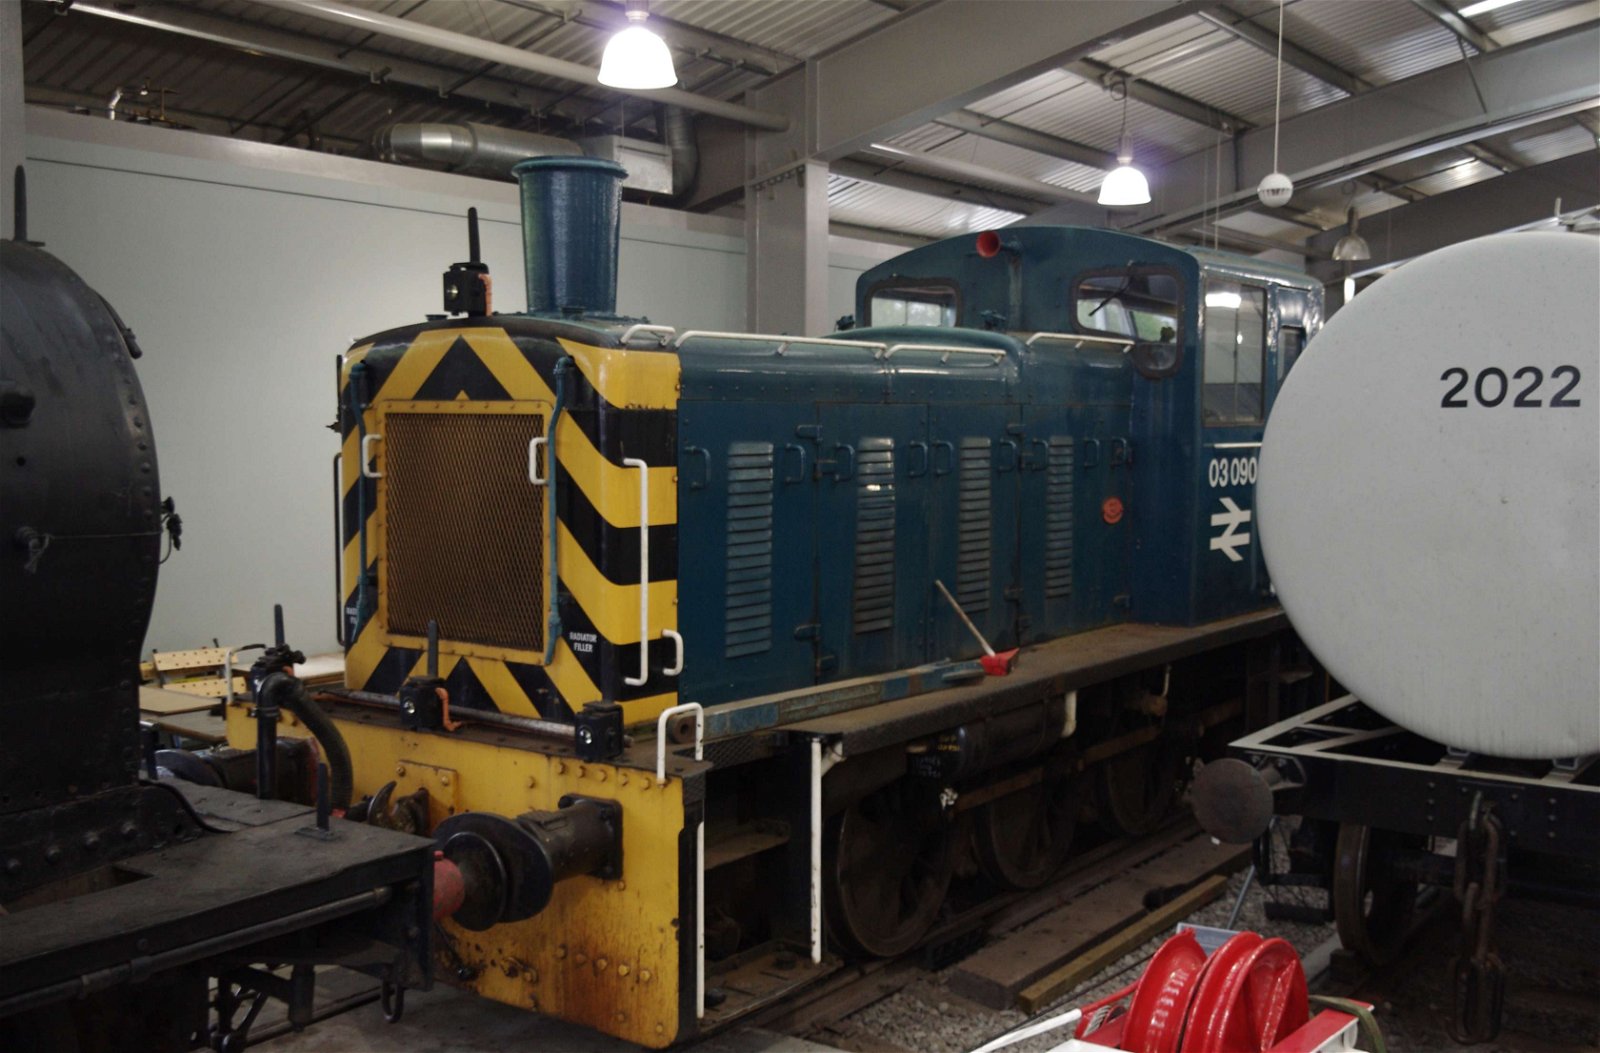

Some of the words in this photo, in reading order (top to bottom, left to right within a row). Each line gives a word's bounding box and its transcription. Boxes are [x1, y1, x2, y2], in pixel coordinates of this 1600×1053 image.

[1440, 365, 1581, 408] 2022
[569, 631, 597, 643] RADIATOR
[574, 642, 593, 652] FILLER
